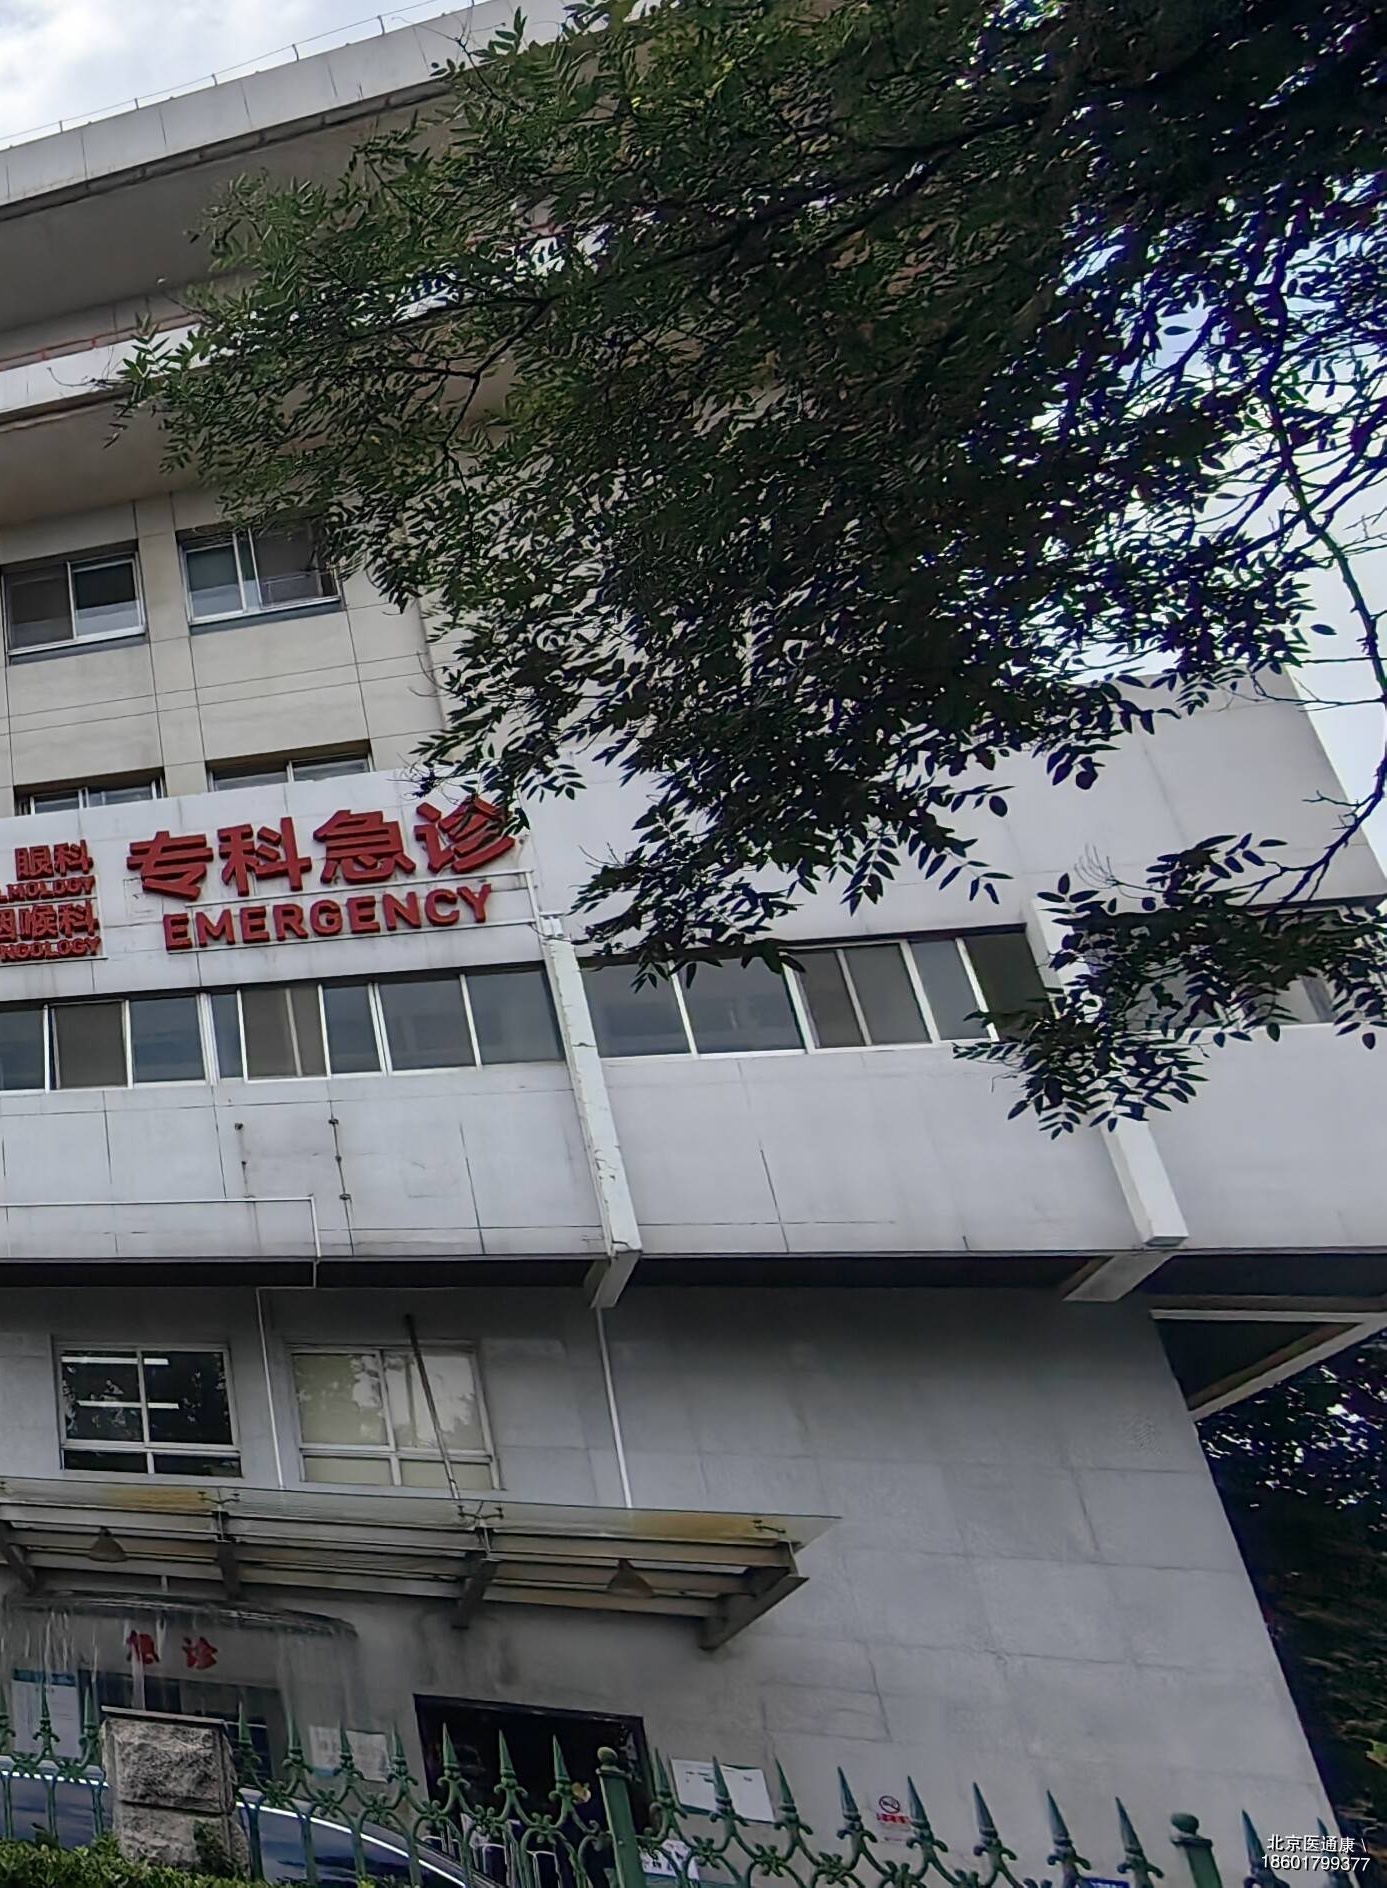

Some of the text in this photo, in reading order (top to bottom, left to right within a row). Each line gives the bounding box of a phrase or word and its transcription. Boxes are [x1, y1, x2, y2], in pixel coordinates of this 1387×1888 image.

[15, 839, 95, 881] 眼科
[126, 795, 517, 900] 专科急诊
[163, 883, 492, 951] EMERGENCY
